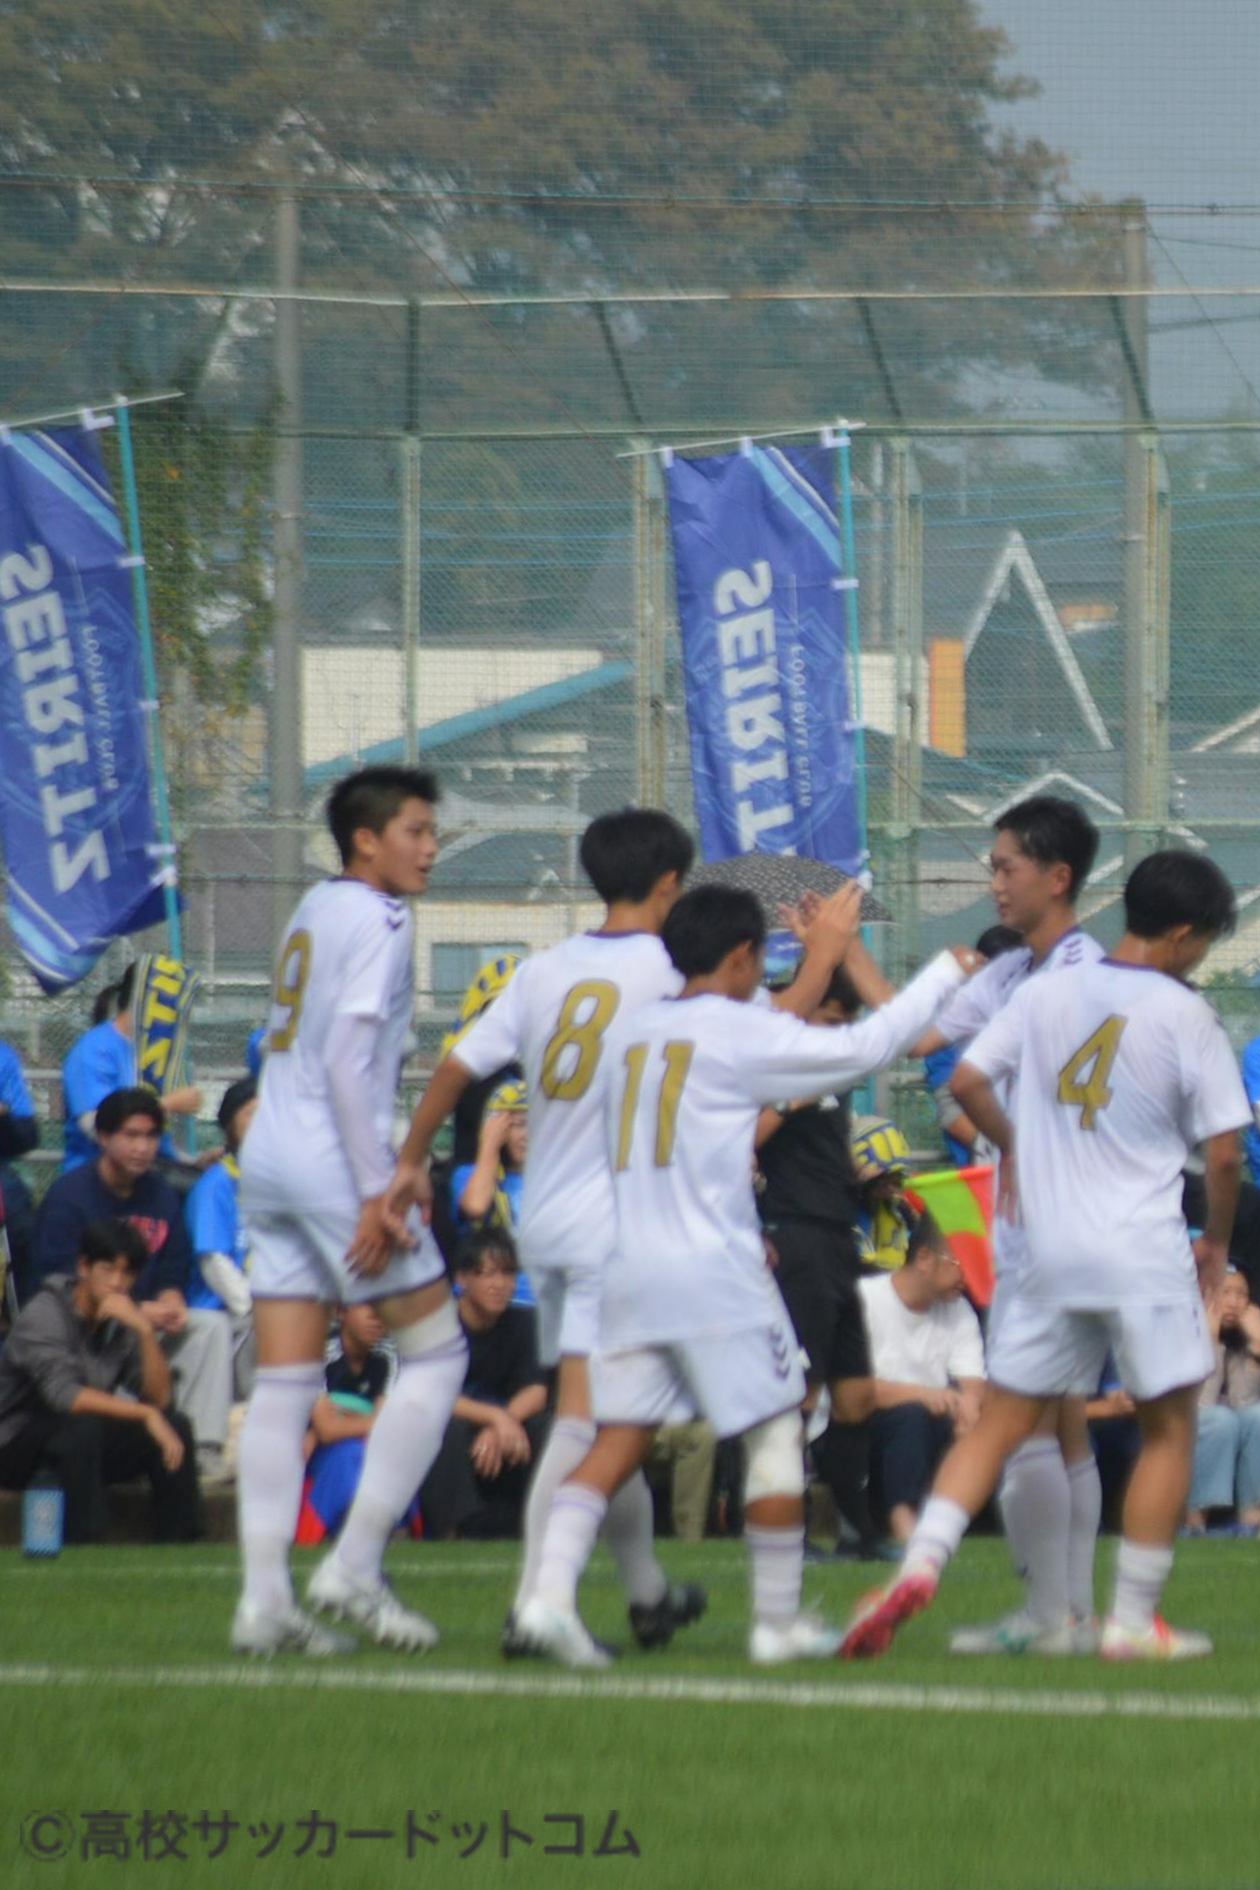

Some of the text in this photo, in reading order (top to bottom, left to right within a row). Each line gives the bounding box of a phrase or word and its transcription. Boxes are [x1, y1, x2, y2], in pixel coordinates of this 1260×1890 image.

[271, 928, 312, 1052] 9
[540, 978, 621, 1101] 8
[616, 1040, 695, 1172] 11
[1057, 1013, 1128, 1132] 4
